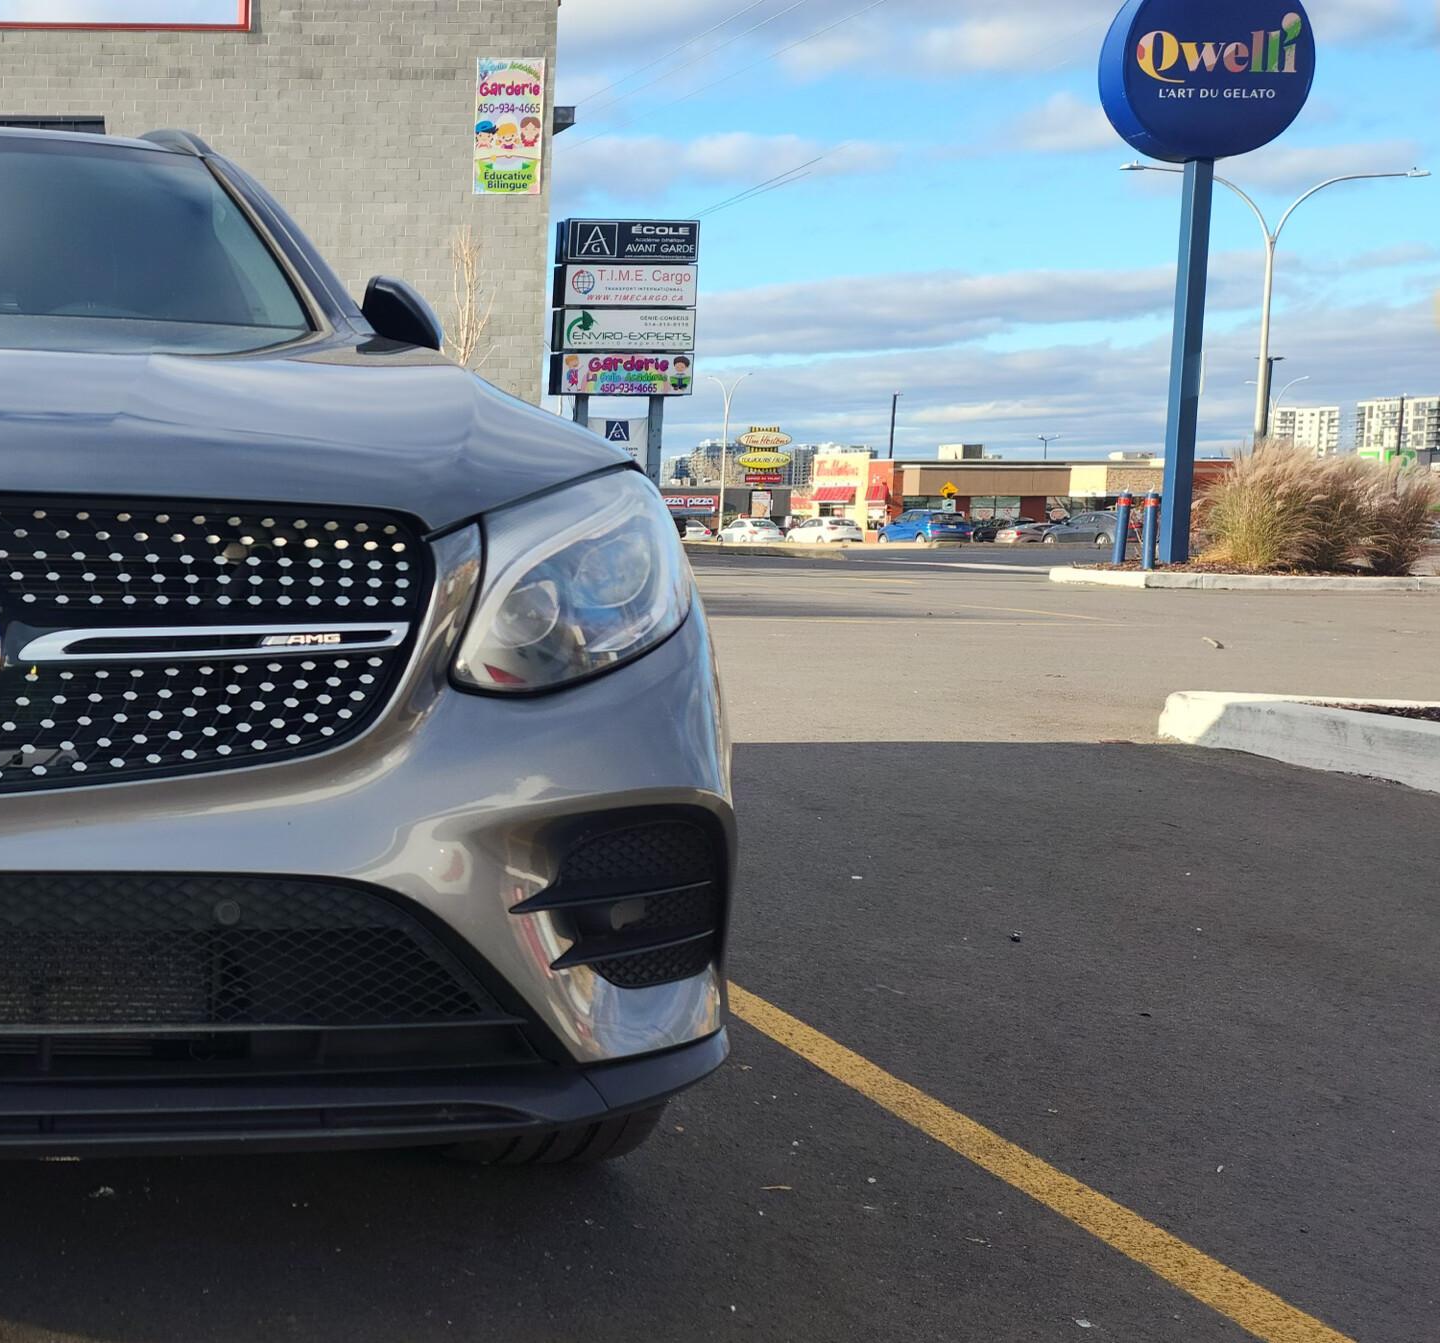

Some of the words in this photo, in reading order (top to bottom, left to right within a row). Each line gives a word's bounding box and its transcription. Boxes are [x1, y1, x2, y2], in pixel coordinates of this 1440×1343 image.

[1136, 12, 1301, 83] Qwelli
[479, 80, 540, 96] Garderie
[1158, 88, 1195, 99] L'ART
[1199, 88, 1219, 99] DU
[1223, 88, 1276, 99] GELATO
[477, 103, 540, 113] 450-934-4665
[487, 180, 528, 191] Bilingue
[631, 223, 690, 235] ÉCOLE
[625, 243, 657, 253] AVANT
[660, 243, 695, 253] GARDE
[597, 270, 647, 281] T.I.M.E.
[652, 270, 691, 285] Cargo
[572, 331, 691, 341] ENVIRO-EXPERTS
[588, 355, 669, 372] Garderie
[600, 383, 658, 392] 450-934-4665
[687, 497, 714, 507] pizza
[287, 632, 341, 645] AMG
